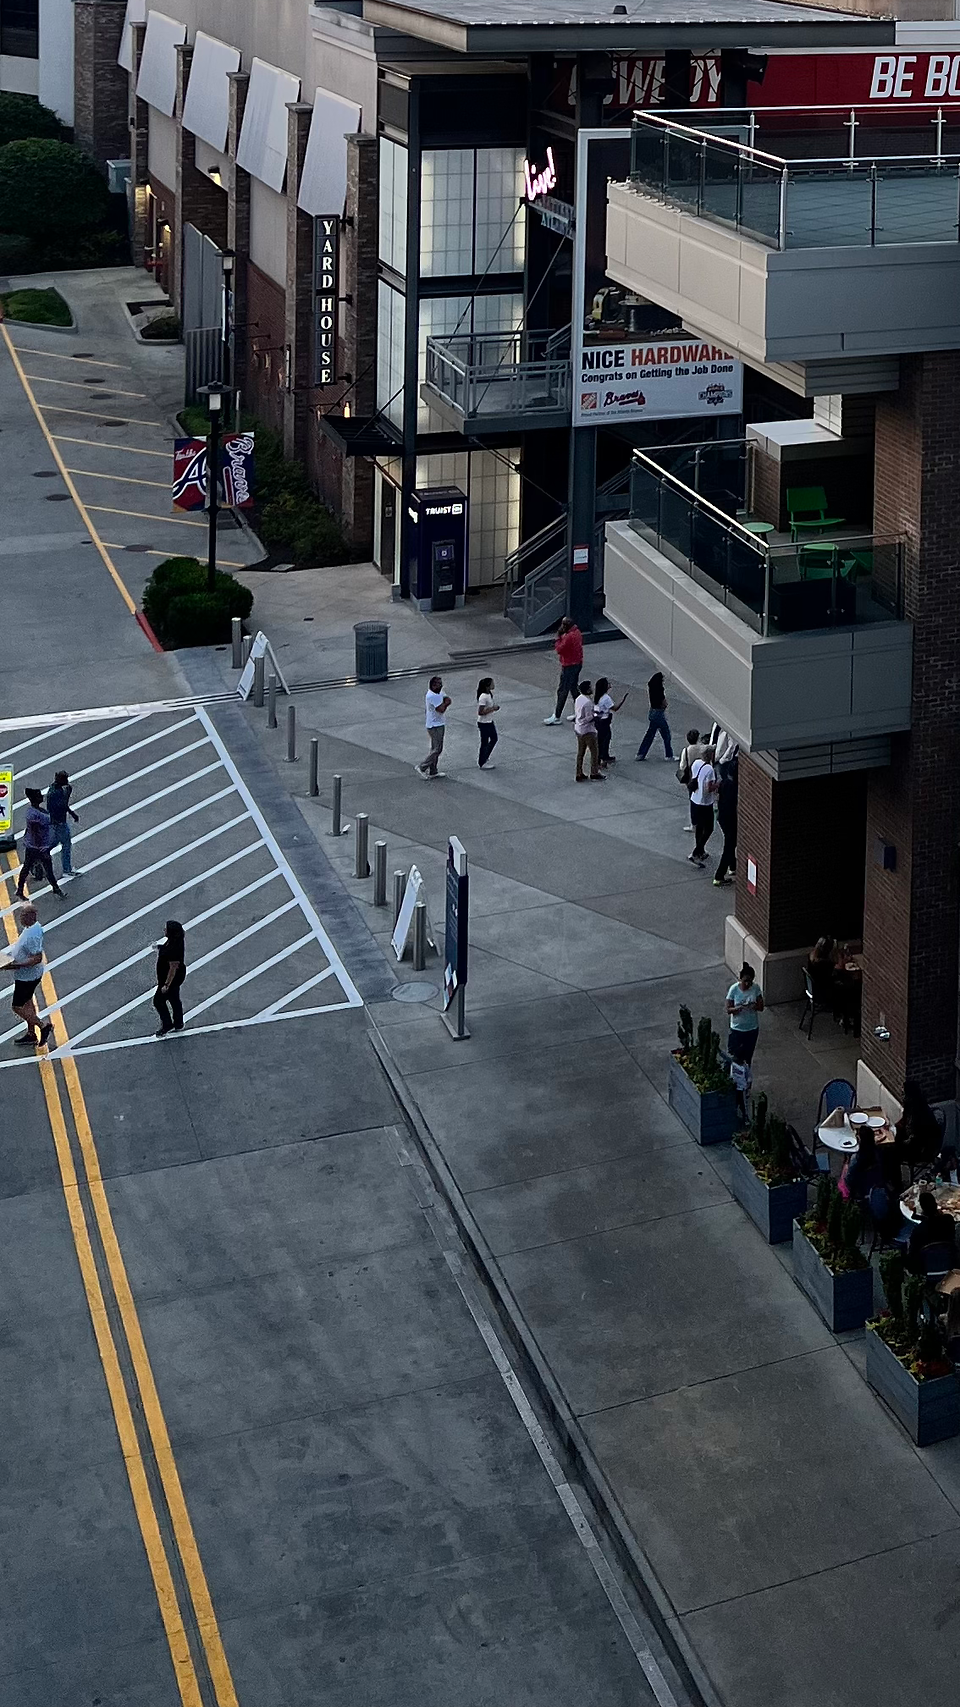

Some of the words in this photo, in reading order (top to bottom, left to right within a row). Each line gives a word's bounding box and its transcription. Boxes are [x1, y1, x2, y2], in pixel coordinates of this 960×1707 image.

[869, 56, 917, 98] BE
[322, 220, 334, 289] YARD
[320, 298, 333, 383] HOUSE
[581, 349, 625, 371] NICE
[631, 343, 734, 366] HARDWAR
[581, 371, 623, 384] Congrats
[625, 372, 637, 380] on
[640, 368, 672, 379] Getting
[675, 366, 690, 376] the
[692, 364, 708, 375] Job
[710, 363, 734, 374] Done
[226, 436, 254, 505] Braves
[426, 505, 452, 516] TRUIST
